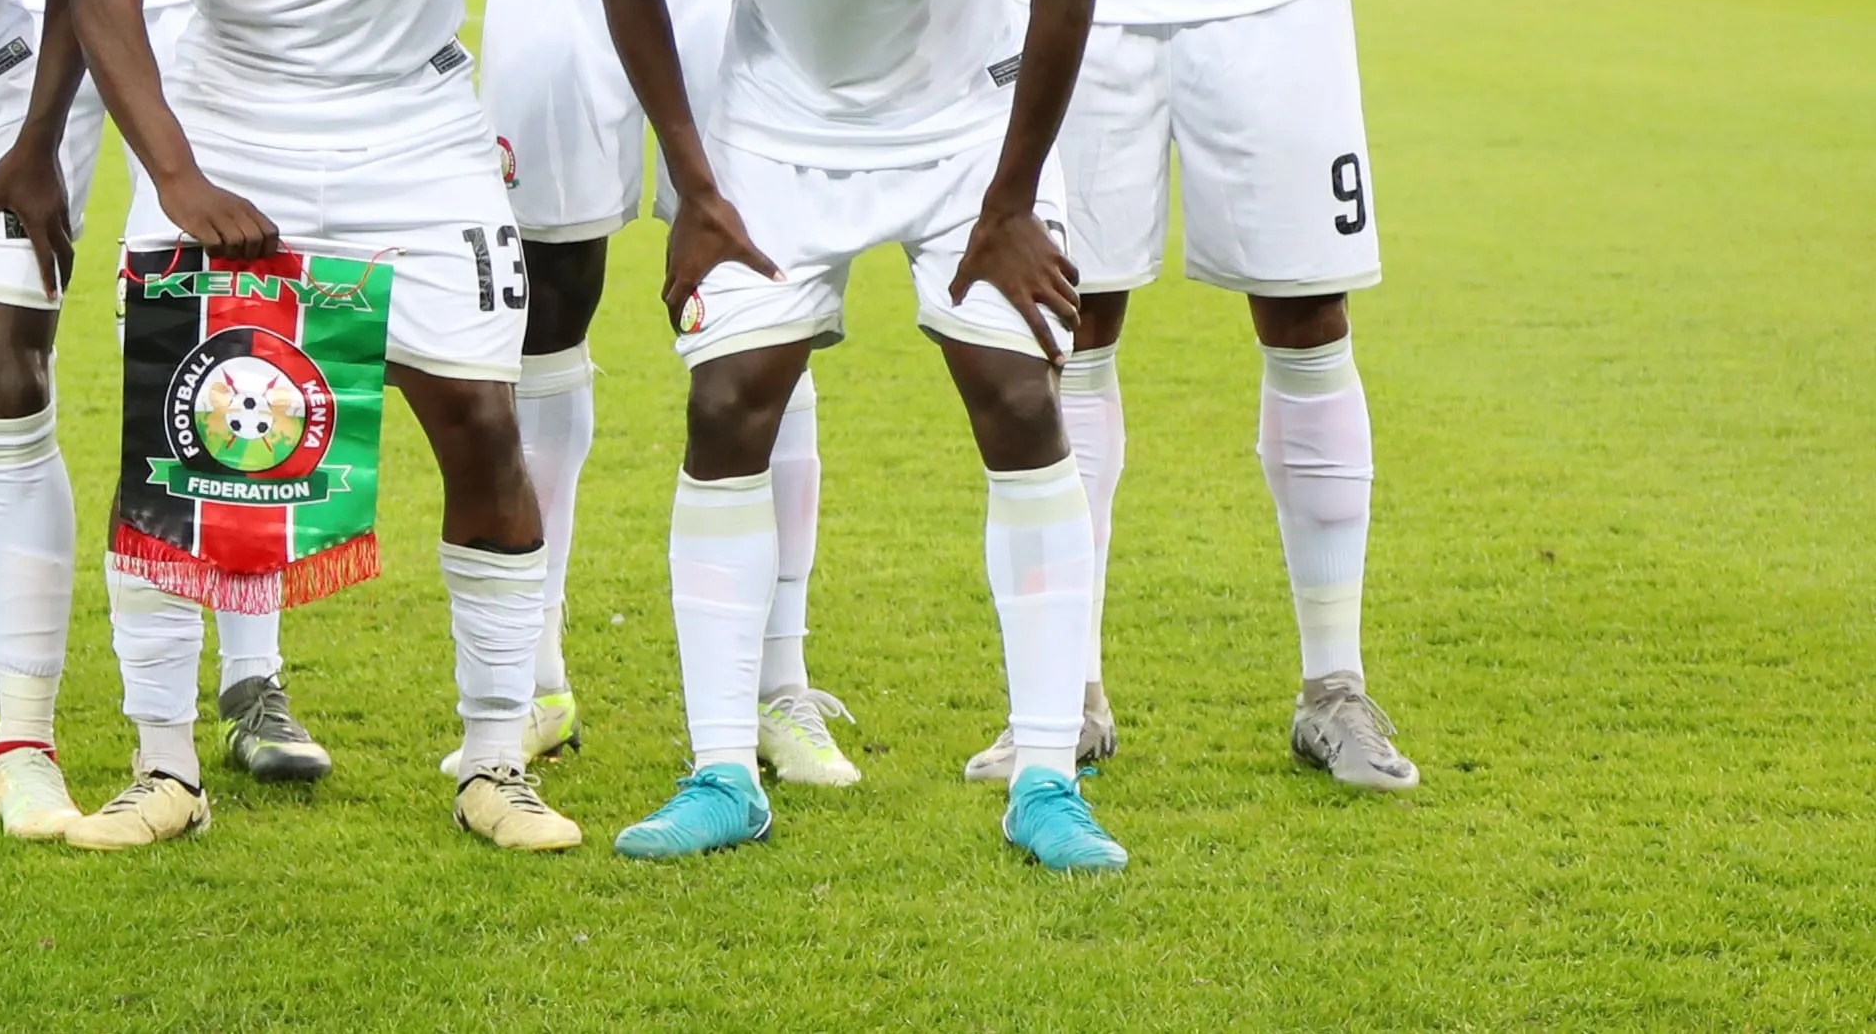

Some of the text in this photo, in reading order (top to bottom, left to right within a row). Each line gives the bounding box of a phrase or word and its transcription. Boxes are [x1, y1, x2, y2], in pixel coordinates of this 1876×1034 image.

[1331, 152, 1367, 236] 9
[143, 271, 373, 312] KENYA
[462, 224, 527, 312] 13
[173, 352, 215, 459] FOOTBALL
[302, 380, 328, 449] KENYA
[187, 477, 310, 501] FEDERATION
